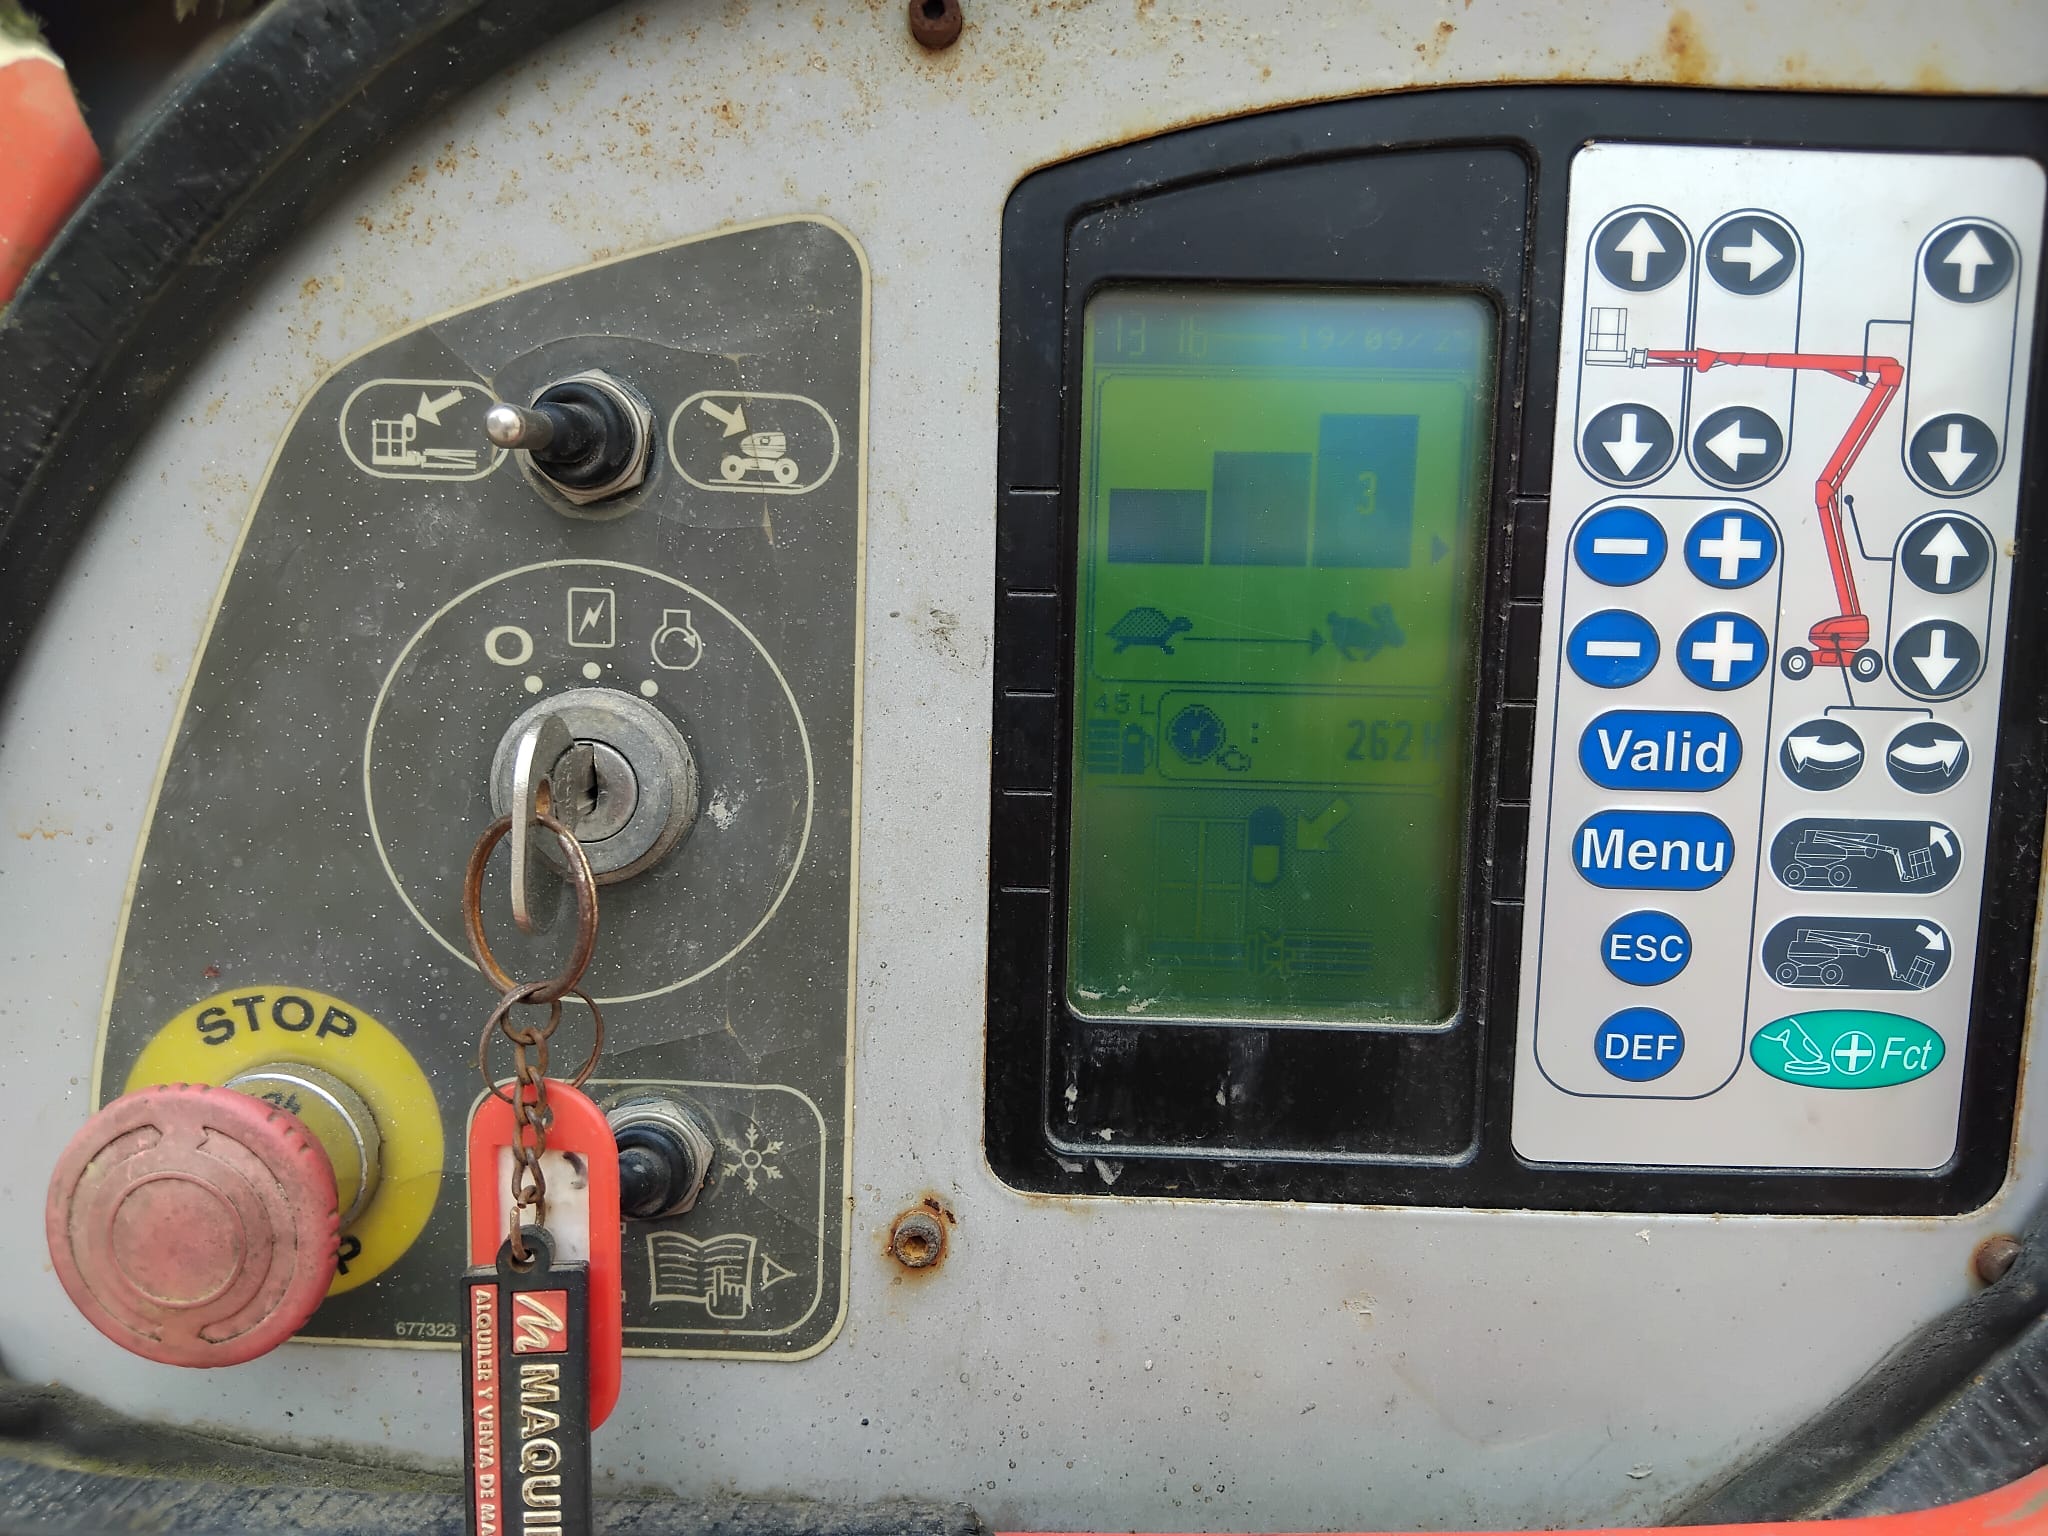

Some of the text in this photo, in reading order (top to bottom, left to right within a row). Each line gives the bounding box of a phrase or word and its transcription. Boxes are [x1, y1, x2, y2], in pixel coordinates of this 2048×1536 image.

[1356, 470, 1377, 515] 3
[1597, 728, 1728, 773] Valid
[1579, 827, 1725, 873] Menu
[1609, 933, 1685, 963] ESC
[196, 994, 358, 1046] STOP
[1604, 1032, 1678, 1061] DEF
[1879, 1035, 1934, 1071] Fct
[395, 1321, 457, 1338] 677323
[475, 1289, 494, 1382] ALQUILER
[477, 1388, 494, 1400] Y
[477, 1404, 495, 1469] VENTA
[479, 1473, 496, 1499] DE
